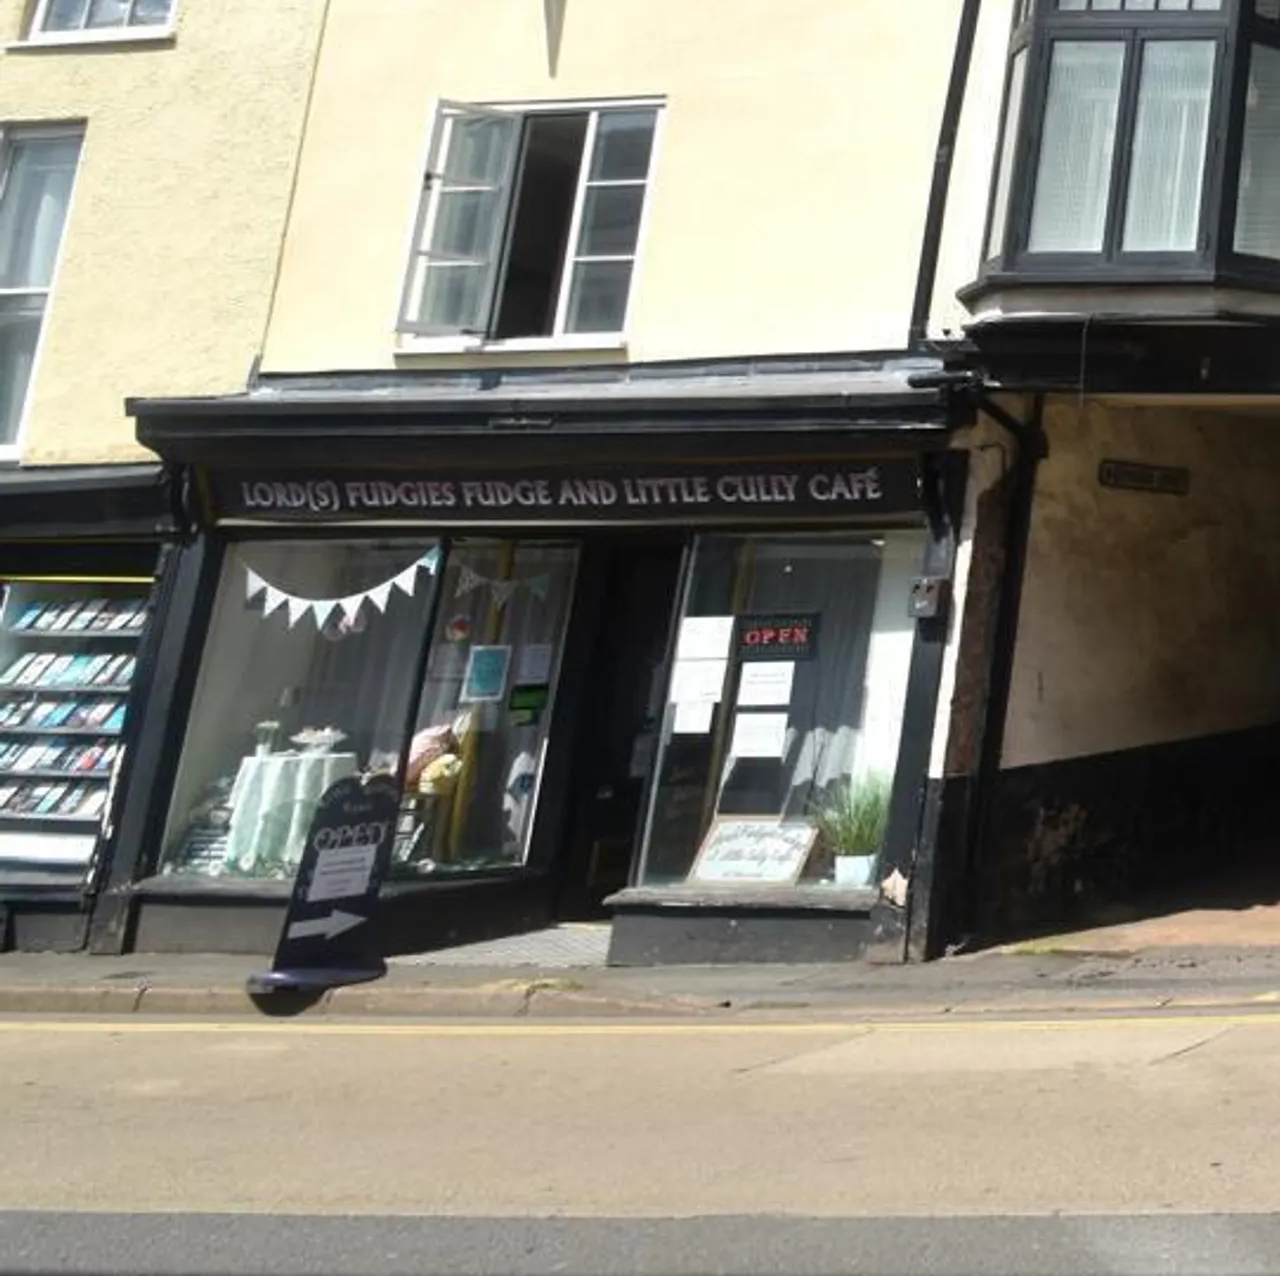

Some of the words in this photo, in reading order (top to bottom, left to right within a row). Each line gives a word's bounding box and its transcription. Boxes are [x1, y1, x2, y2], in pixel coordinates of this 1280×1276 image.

[240, 480, 340, 511] LORD(S)
[345, 480, 455, 507] FUDGIES
[461, 479, 552, 507] FUDGE
[558, 478, 618, 505] AND
[623, 476, 710, 504] LITTLE
[716, 474, 800, 502] CULLY
[743, 626, 810, 647] OPEN
